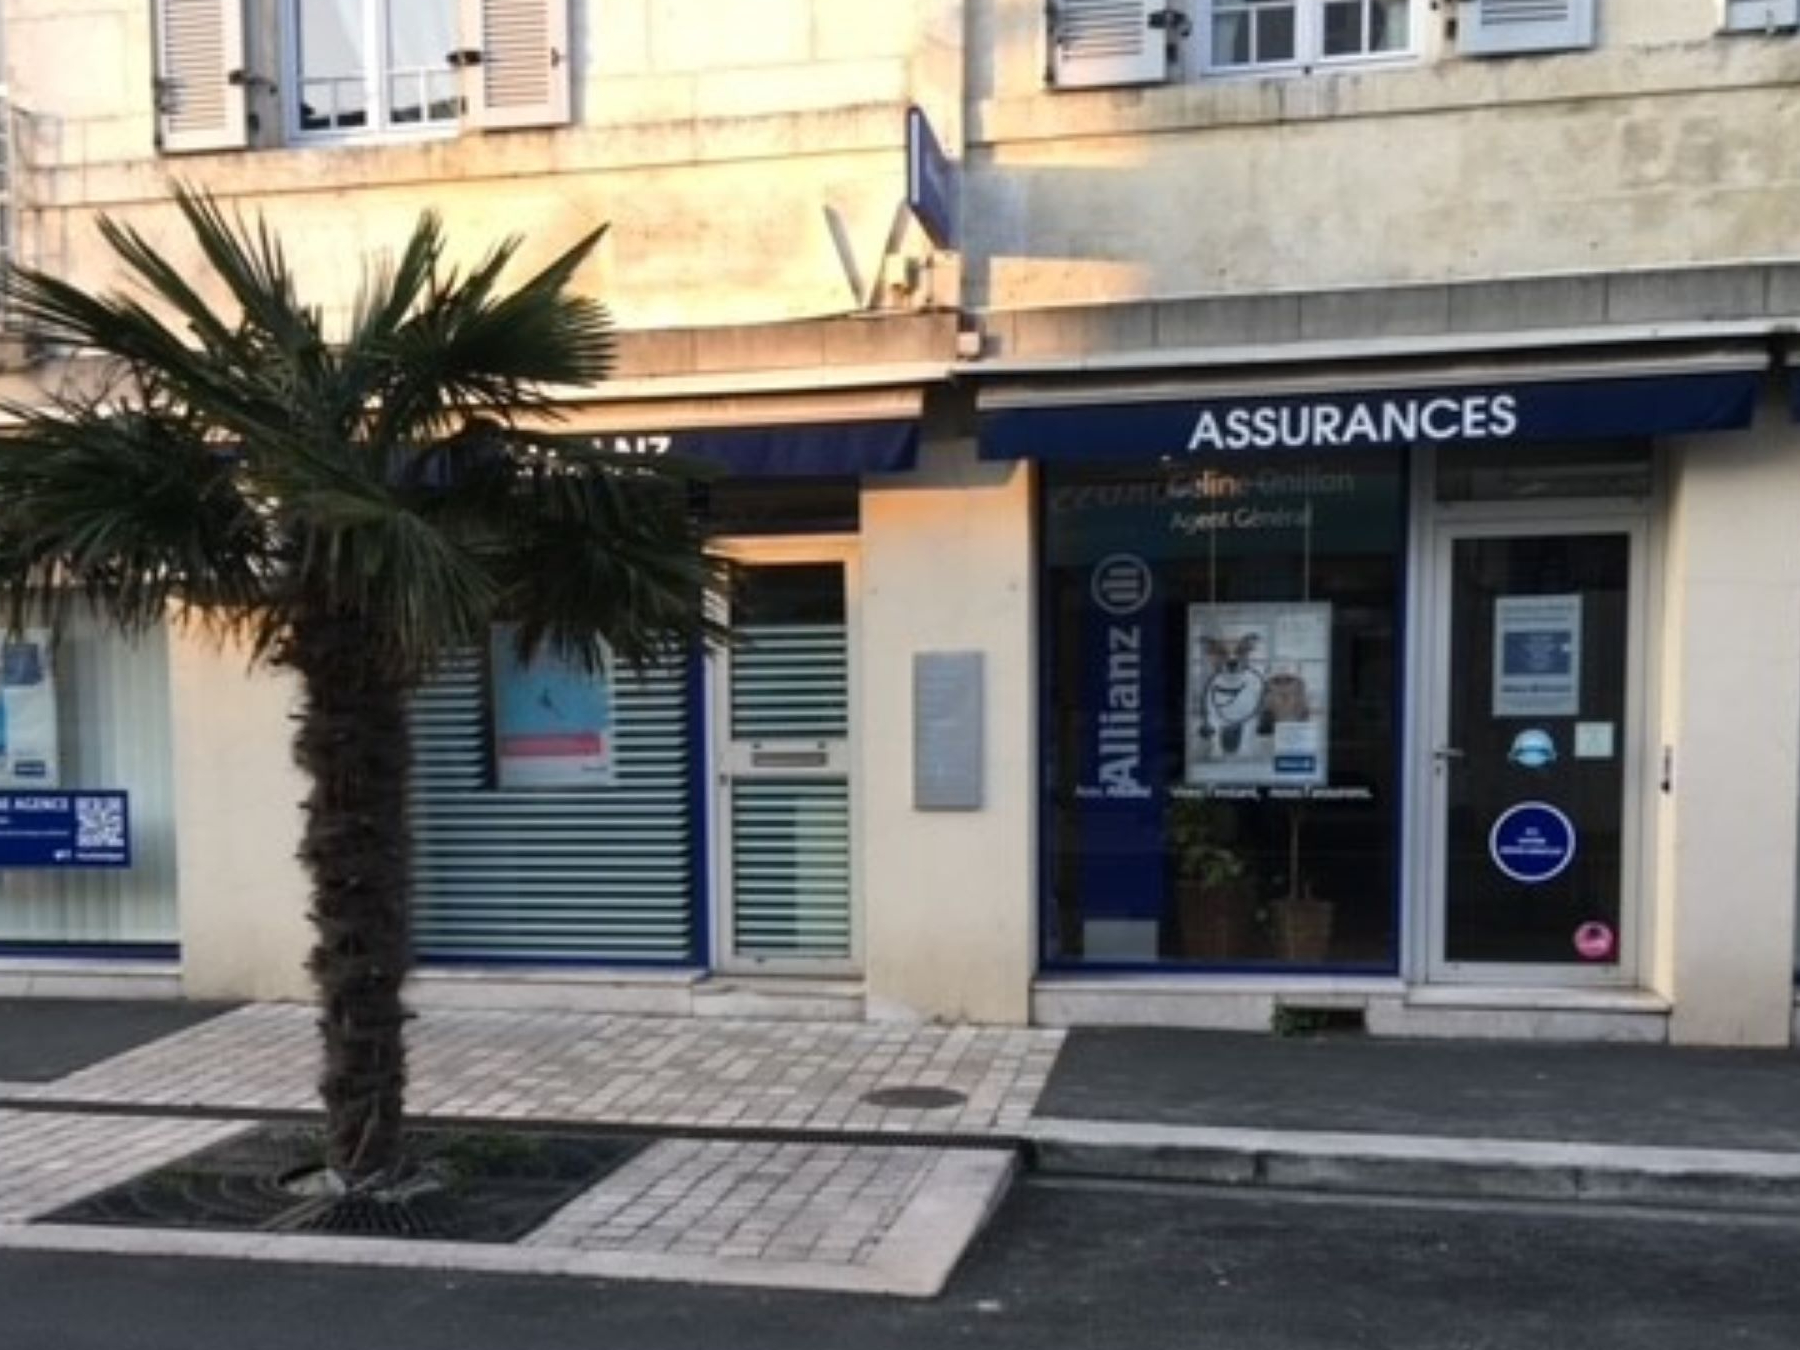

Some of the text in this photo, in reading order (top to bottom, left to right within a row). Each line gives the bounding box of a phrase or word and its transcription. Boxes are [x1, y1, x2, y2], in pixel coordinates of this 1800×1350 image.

[1187, 395, 1518, 450] ASSURANCES
[1169, 510, 1231, 535] Agent
[1098, 624, 1142, 792] Allianz
